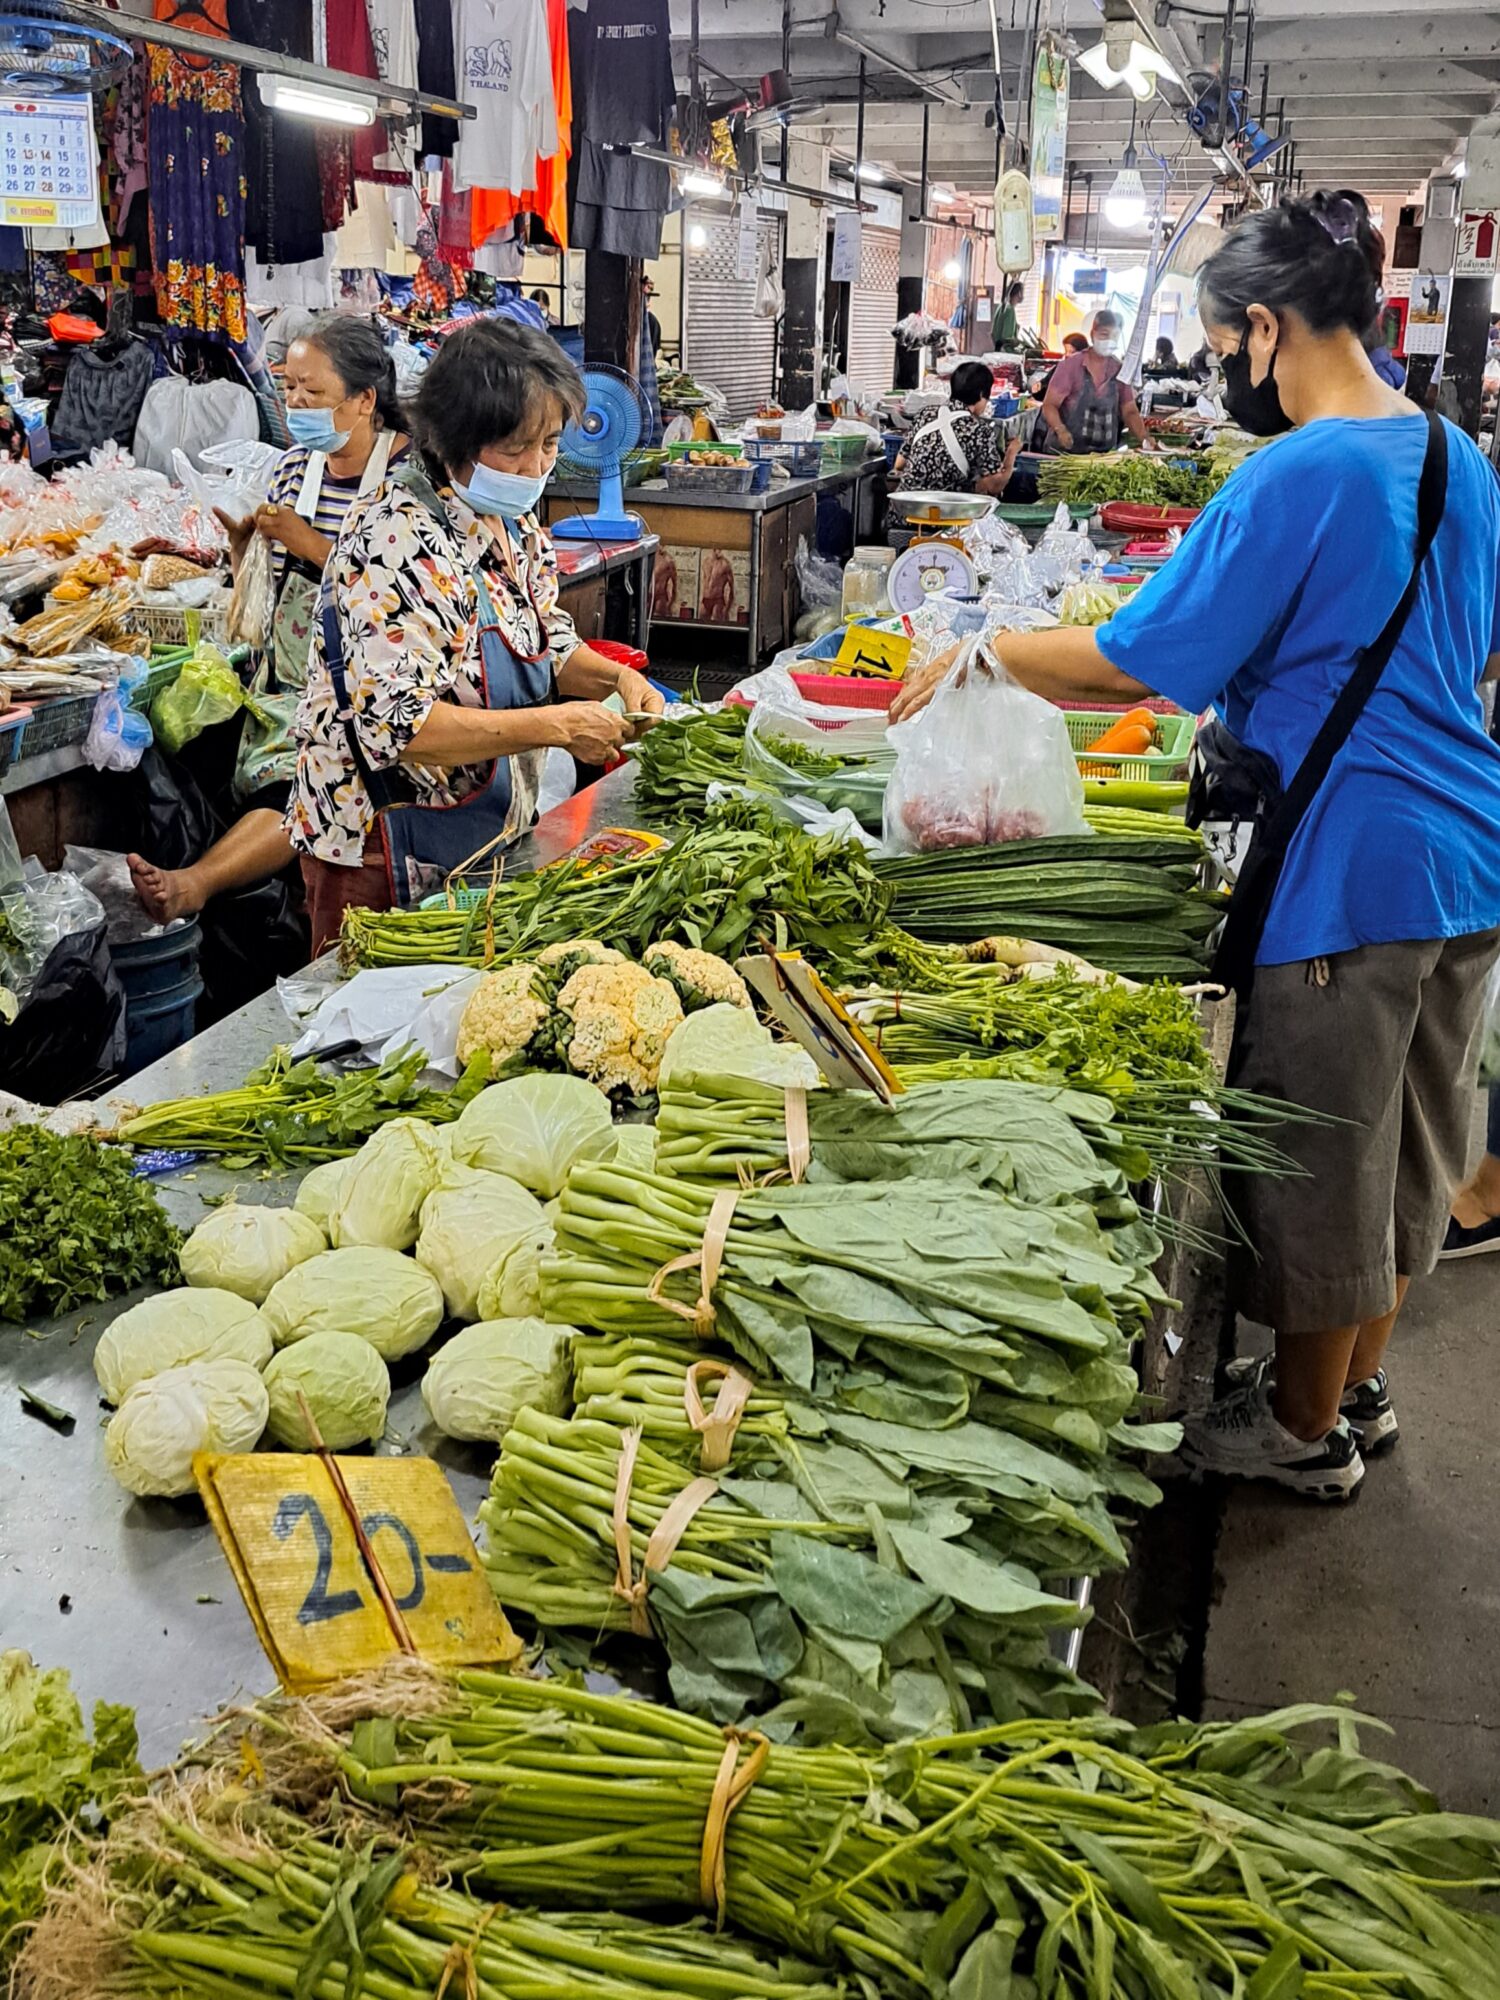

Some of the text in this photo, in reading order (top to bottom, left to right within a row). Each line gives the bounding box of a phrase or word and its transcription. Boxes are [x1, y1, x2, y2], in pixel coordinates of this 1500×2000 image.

[76, 121, 82, 130] 2
[7, 132, 83, 147] 5 6 7 8 9
[5, 148, 86, 163] 12 13 14 15 16
[6, 164, 87, 179] 19 20 21 22 23
[6, 180, 88, 194] 26 27 28 29 30
